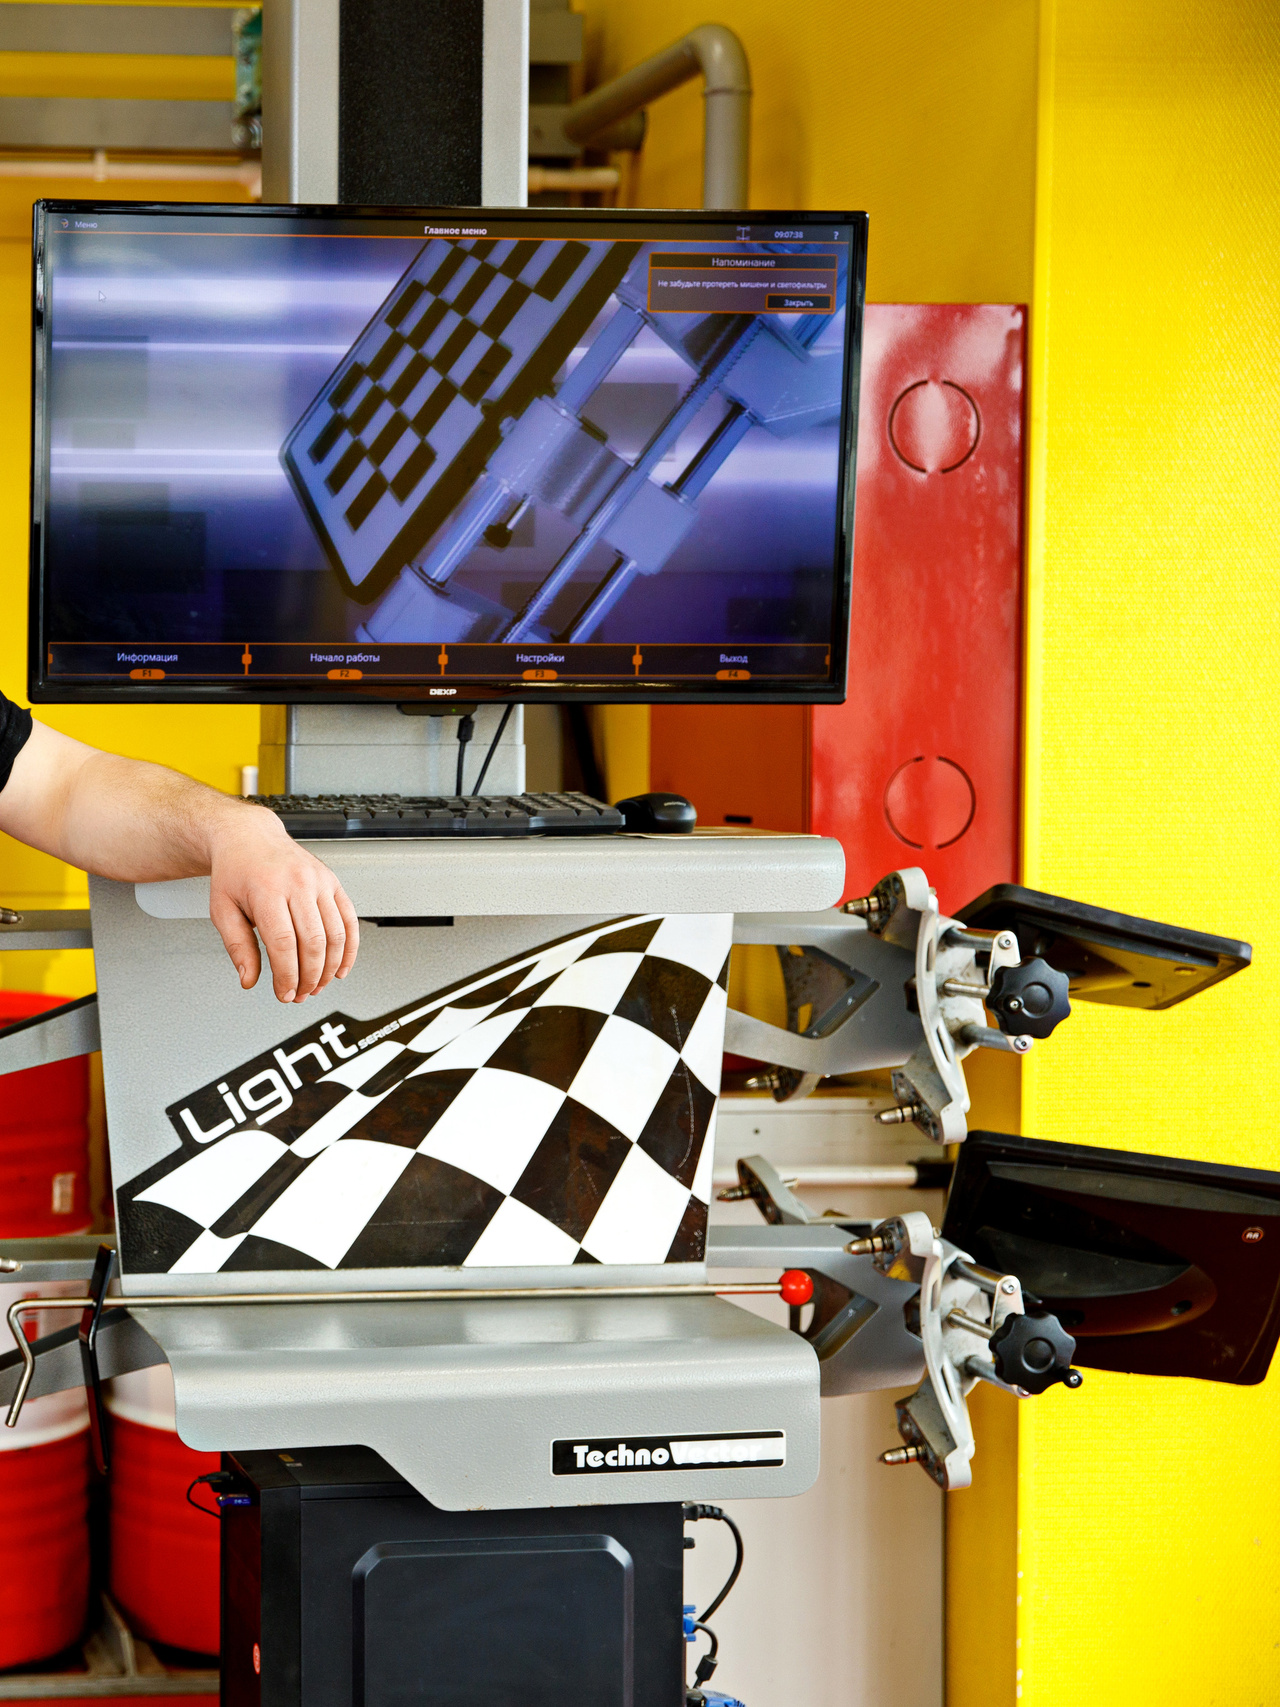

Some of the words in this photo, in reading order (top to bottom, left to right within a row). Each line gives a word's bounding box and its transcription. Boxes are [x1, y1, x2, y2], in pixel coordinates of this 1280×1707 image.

[74, 221, 98, 229] Меню
[424, 226, 460, 235] Главное
[711, 257, 776, 268] Напоминание
[658, 280, 669, 288] Не
[669, 279, 701, 289] забудьте
[702, 280, 739, 289] протереть
[740, 281, 769, 289] мишени
[777, 281, 827, 290] светофильтры
[783, 299, 814, 308] Закрыть
[117, 652, 178, 664] Информация
[310, 653, 344, 663] Начало
[345, 653, 380, 665] работы
[516, 653, 565, 665] Настройки
[719, 653, 749, 664] Выход
[429, 688, 458, 696] DEXP
[179, 1022, 359, 1144] Light
[357, 1020, 401, 1049] SERIES
